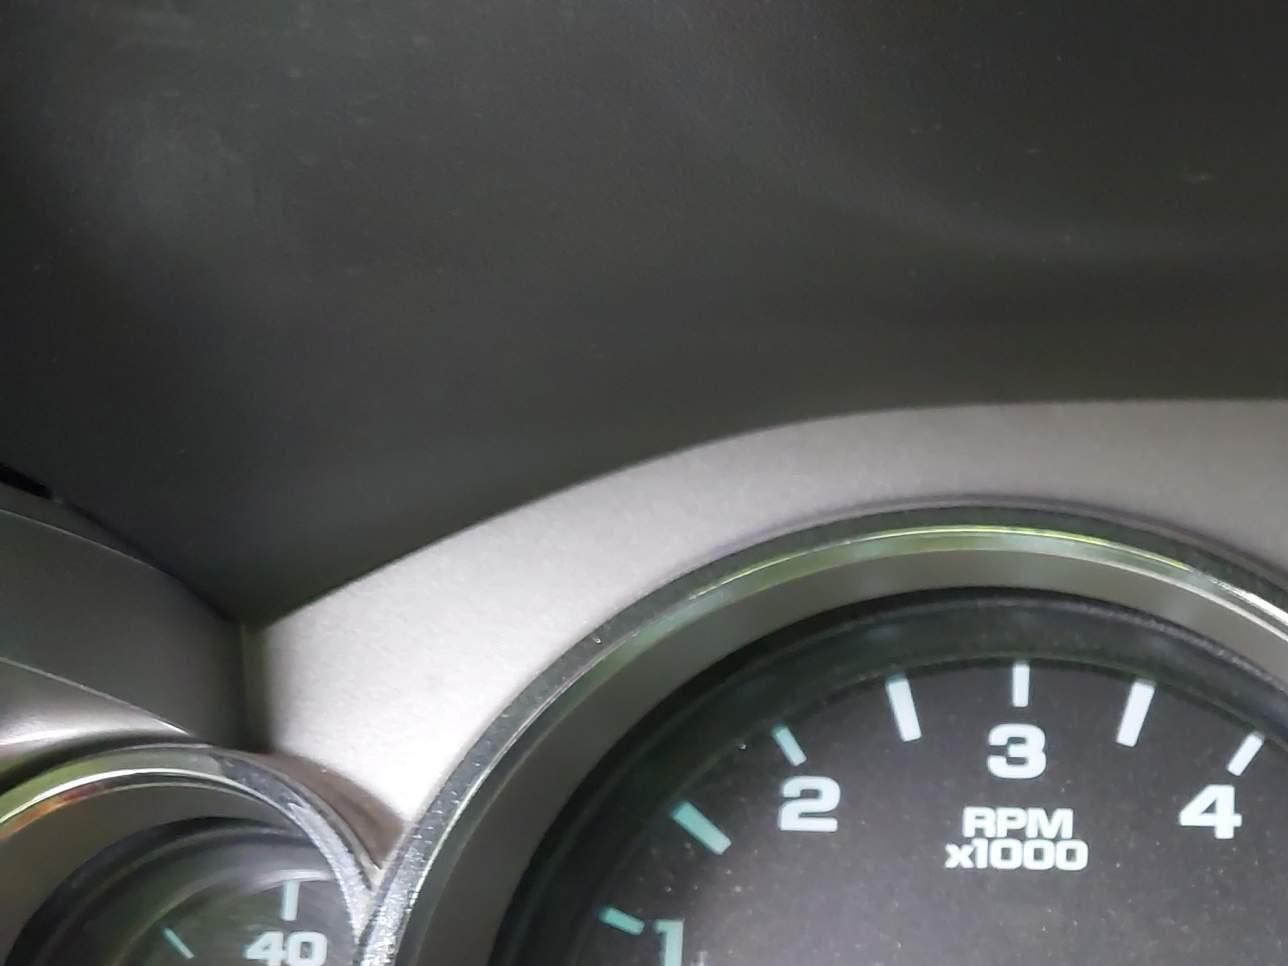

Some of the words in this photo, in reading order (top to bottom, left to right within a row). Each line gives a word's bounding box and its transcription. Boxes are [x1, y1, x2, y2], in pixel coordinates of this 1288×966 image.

[987, 724, 1046, 778] 3
[779, 777, 840, 832] 2
[963, 808, 1073, 838] RPM
[1179, 786, 1242, 838] 4
[945, 840, 1088, 870] x1000
